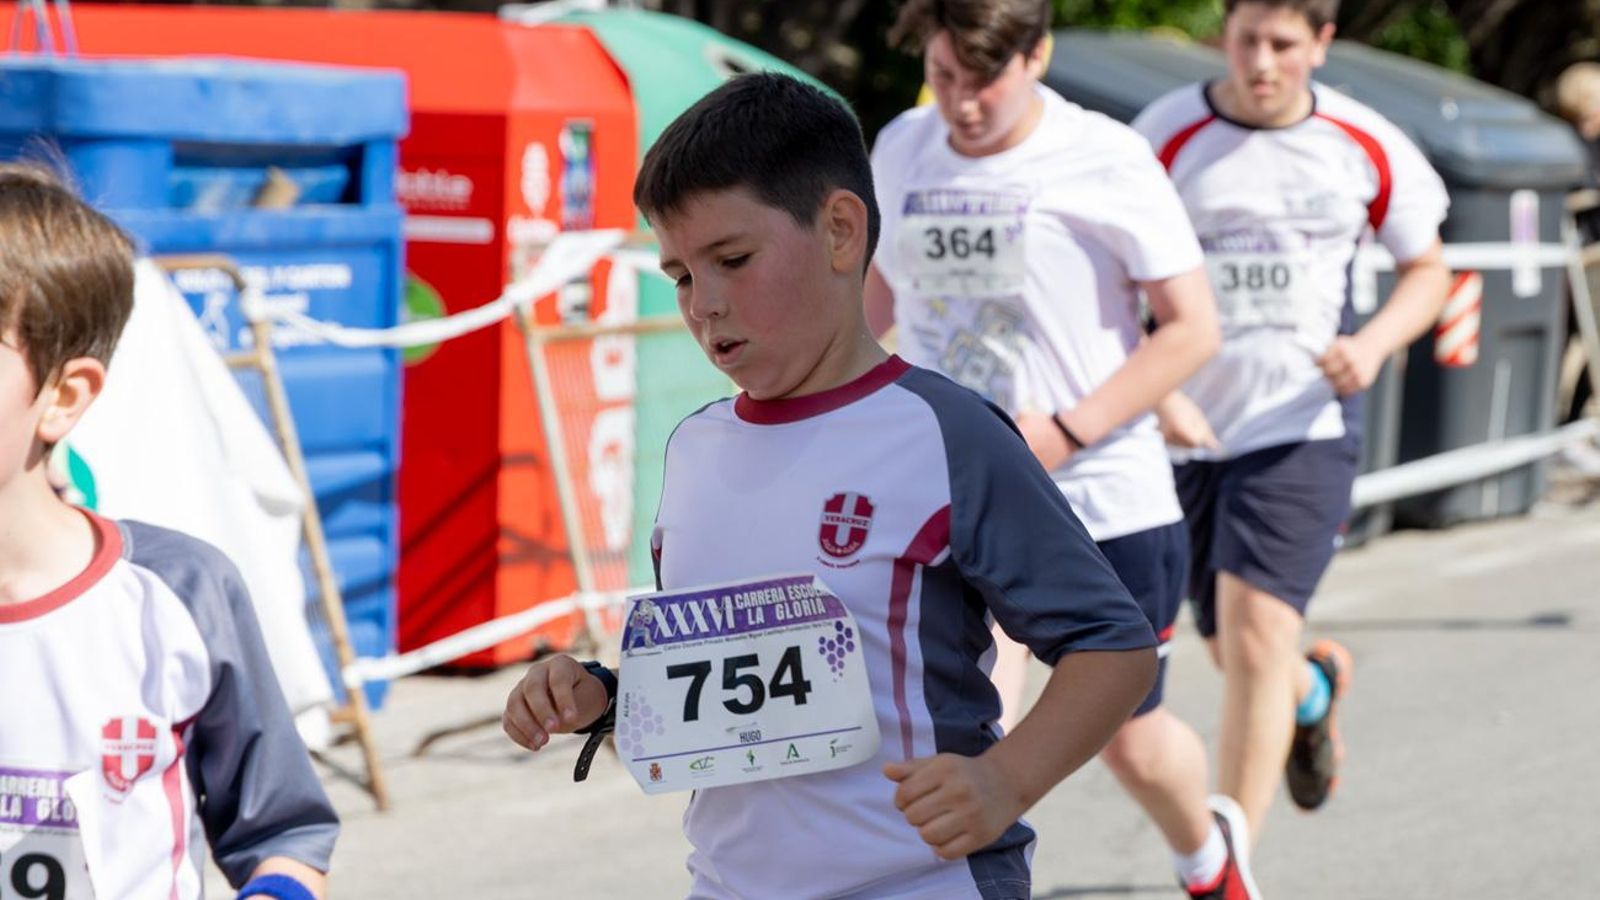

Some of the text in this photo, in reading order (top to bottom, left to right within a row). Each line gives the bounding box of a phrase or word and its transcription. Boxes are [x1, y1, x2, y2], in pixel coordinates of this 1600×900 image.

[925, 227, 996, 260] 364
[1220, 262, 1291, 293] 380
[735, 588, 786, 610] CARRERA
[747, 598, 827, 626] LA GLORIA
[653, 594, 737, 640] XXXVI
[666, 645, 813, 723] 754
[739, 729, 762, 743] HUGO
[0, 774, 58, 799] ARRERA
[0, 795, 78, 822] LA GLO
[0, 850, 67, 900] 9
